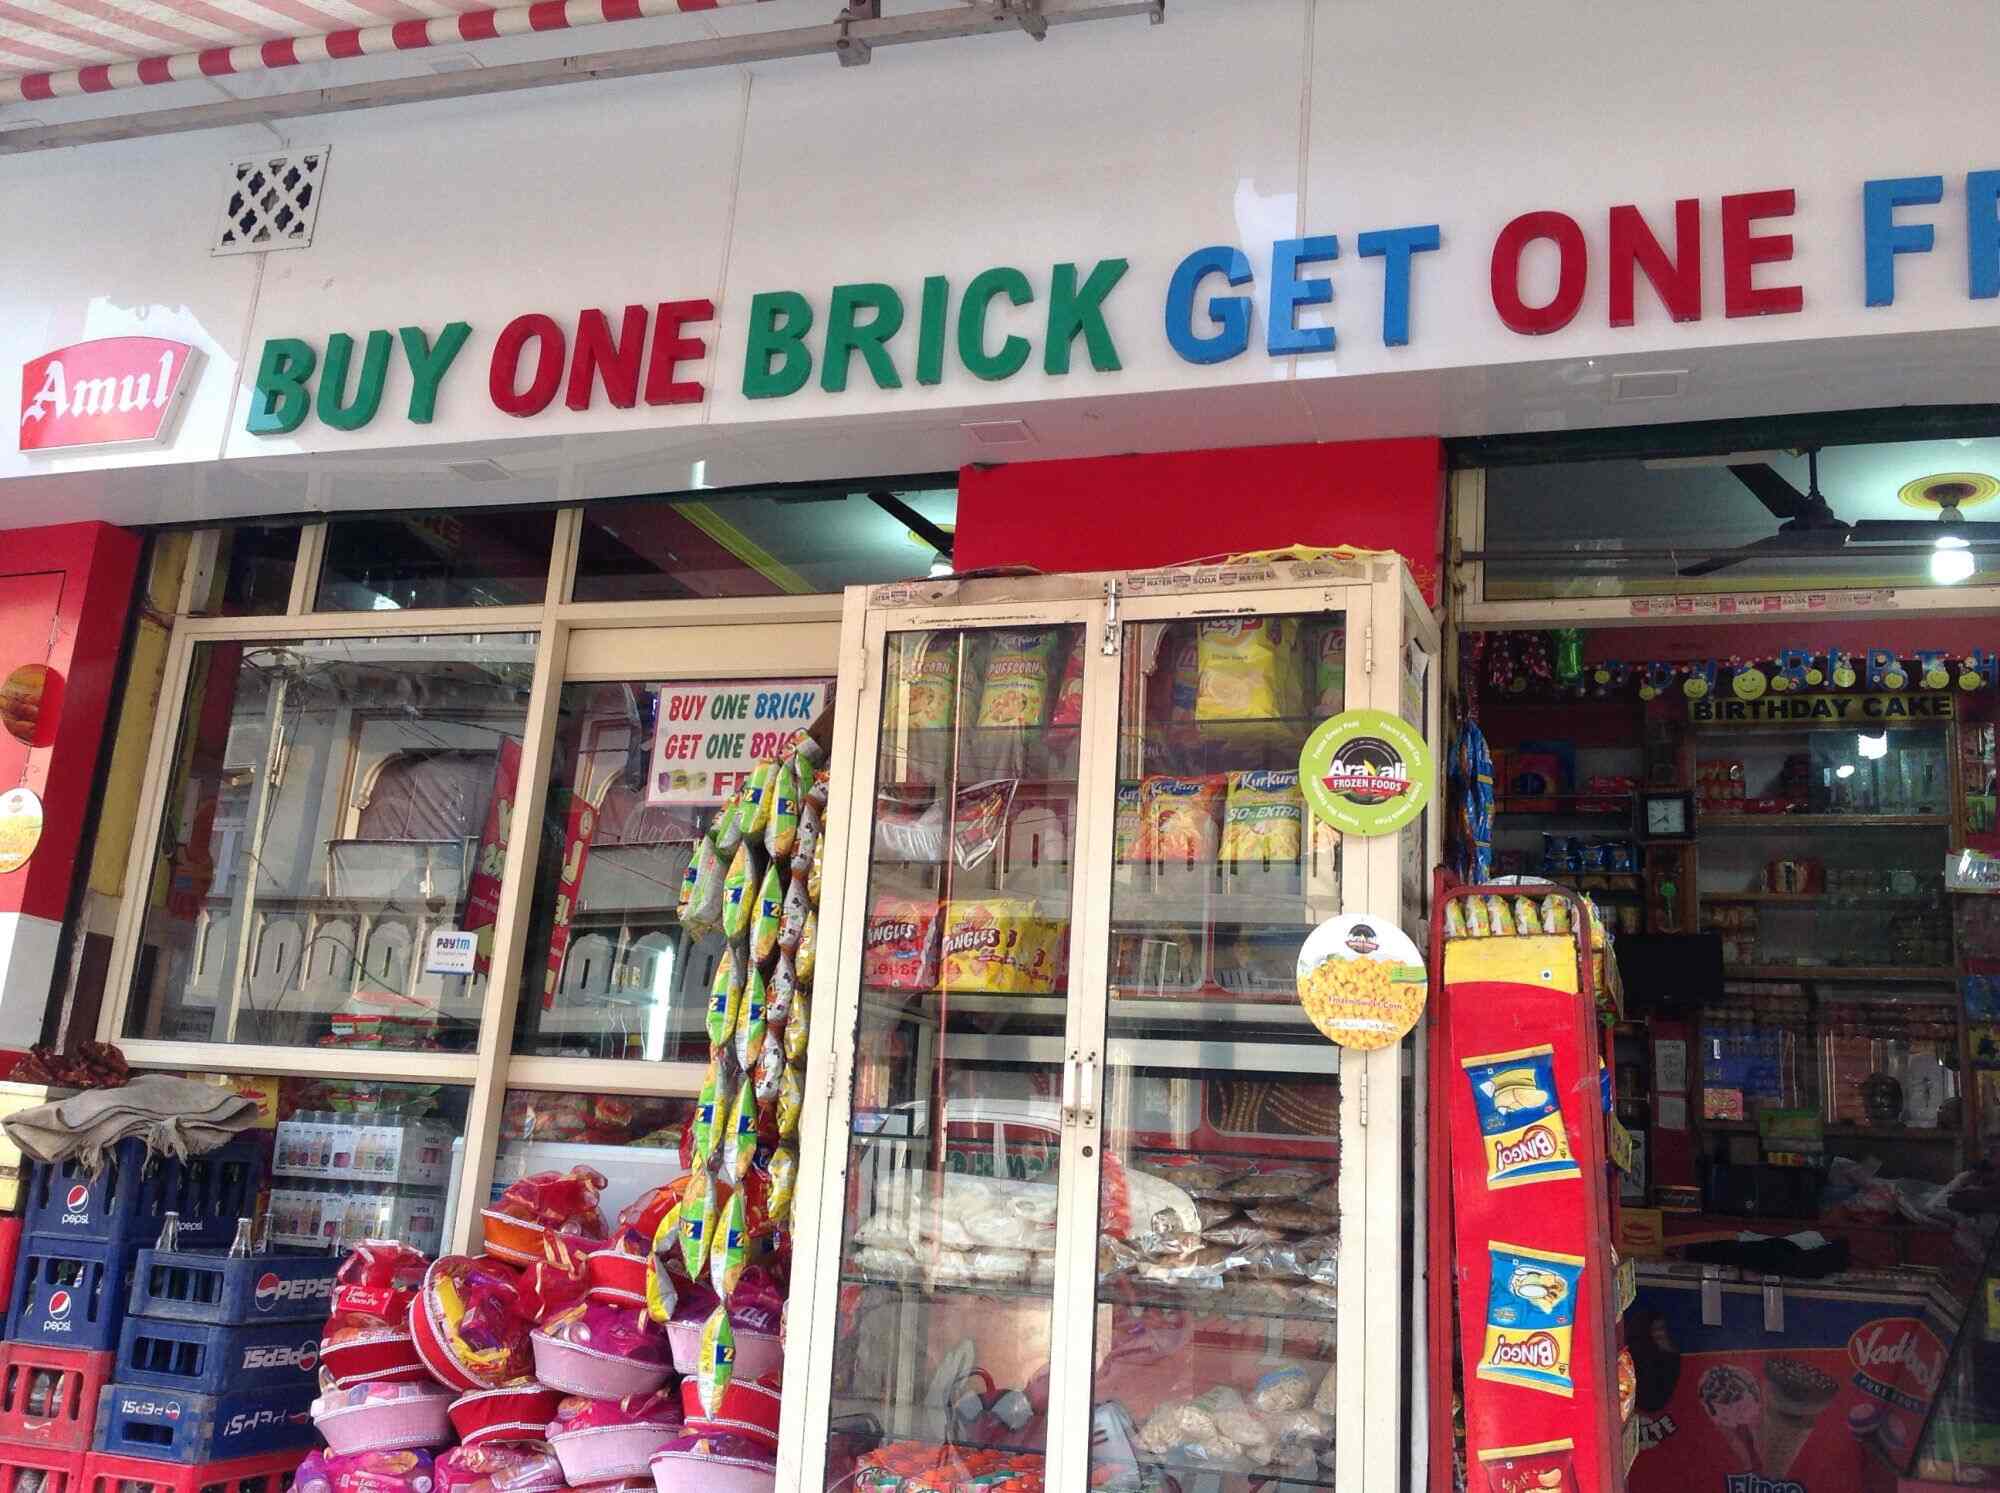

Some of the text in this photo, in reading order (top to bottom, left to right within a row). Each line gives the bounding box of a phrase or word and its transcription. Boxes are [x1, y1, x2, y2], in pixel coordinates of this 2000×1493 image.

[246, 320, 471, 436] BUY
[489, 298, 715, 418] ONE
[742, 257, 1129, 399] BRICK
[1164, 224, 1440, 365] GET
[1490, 188, 1804, 337] ONE
[22, 351, 174, 424] Amul
[668, 691, 815, 721] BUY ONE BRICK
[1693, 696, 1951, 722] BIRTHDAY CAKE
[664, 734, 703, 760] GET
[706, 733, 746, 759] ONE
[1333, 778, 1402, 791] FROZEN FOODS
[1256, 805, 1301, 819] EXTRA
[1496, 1131, 1553, 1171] BINGO!
[62, 1212, 89, 1225] pepsi
[43, 1320, 71, 1333] pepsi
[242, 1346, 299, 1369] PEPSI
[1492, 1335, 1555, 1367] BINGO!
